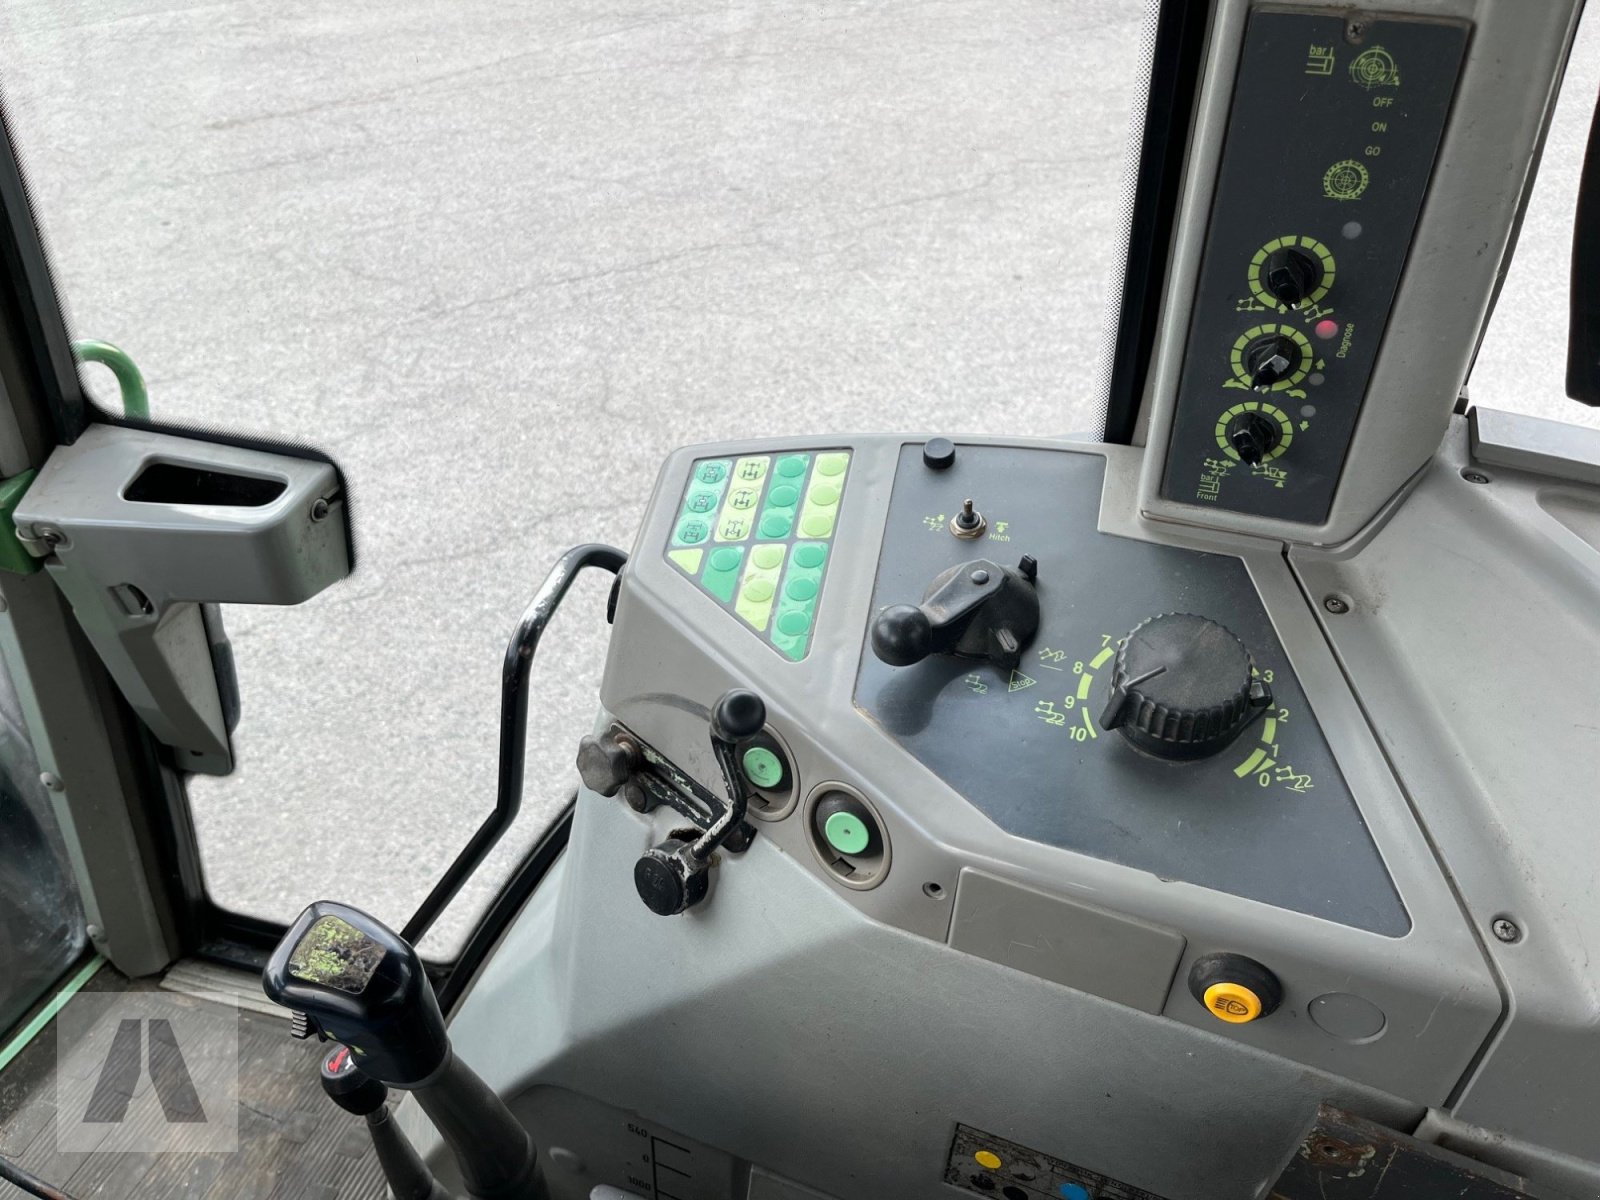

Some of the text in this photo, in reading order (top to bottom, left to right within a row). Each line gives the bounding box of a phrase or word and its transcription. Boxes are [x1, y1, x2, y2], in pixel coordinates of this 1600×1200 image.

[1309, 43, 1328, 56] bar
[1373, 97, 1393, 108] OFF
[1371, 121, 1388, 133] ON
[1364, 145, 1381, 156] GO
[1336, 323, 1354, 358] Diagnose
[1196, 491, 1218, 501] Front
[988, 532, 1011, 543] Hitch
[1102, 634, 1112, 646] 7
[1072, 661, 1083, 674] 8
[1263, 669, 1274, 683] 3
[1011, 678, 1031, 689] Stop
[1064, 695, 1075, 710] 9
[1277, 708, 1289, 722] 2
[1068, 726, 1088, 742] 10
[1271, 743, 1279, 757] 1
[1258, 773, 1270, 787] 0
[628, 1123, 648, 1138] 540
[642, 1154, 650, 1163] 0
